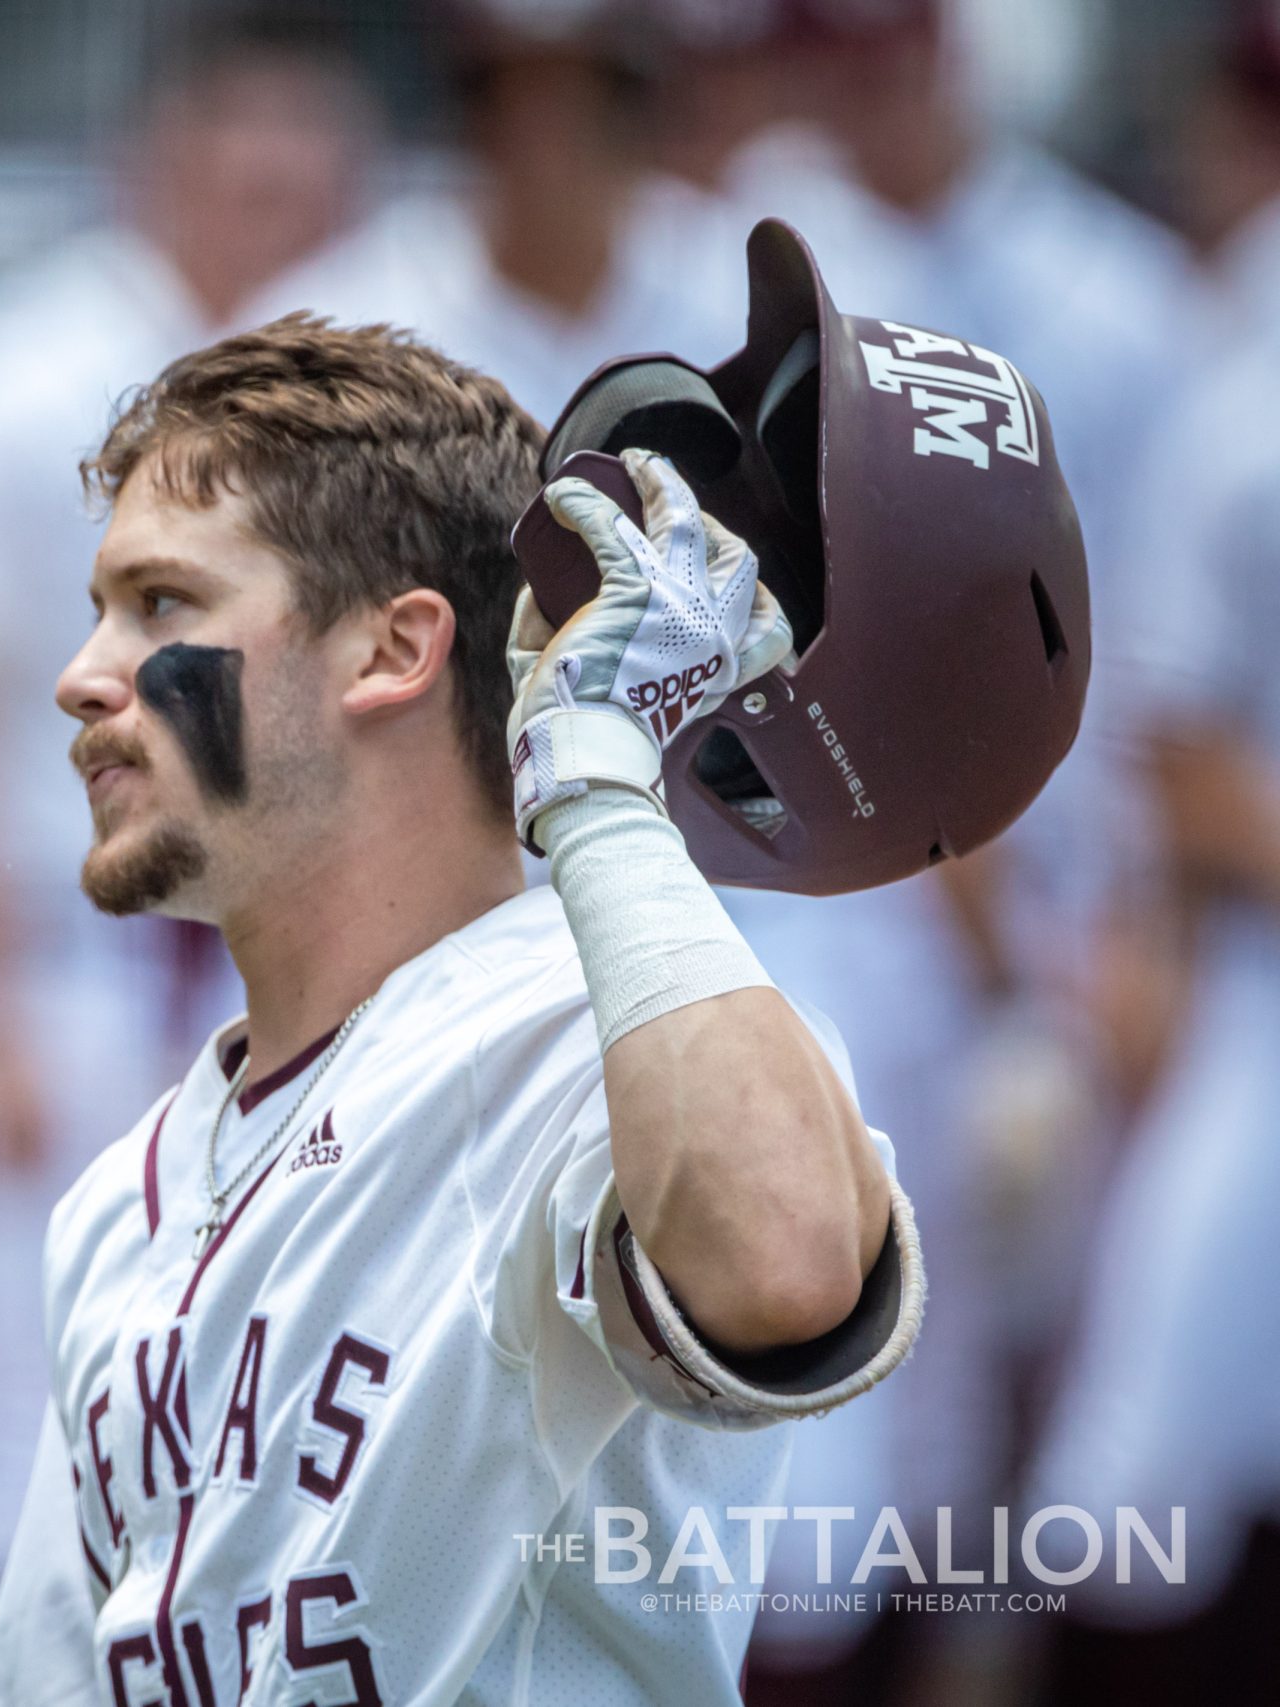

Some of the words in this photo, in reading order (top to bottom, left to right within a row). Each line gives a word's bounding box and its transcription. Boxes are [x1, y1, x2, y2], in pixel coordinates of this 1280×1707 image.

[627, 654, 722, 712] adidas
[808, 702, 875, 818] EVOSHIELD
[74, 1317, 390, 1592] EXAS
